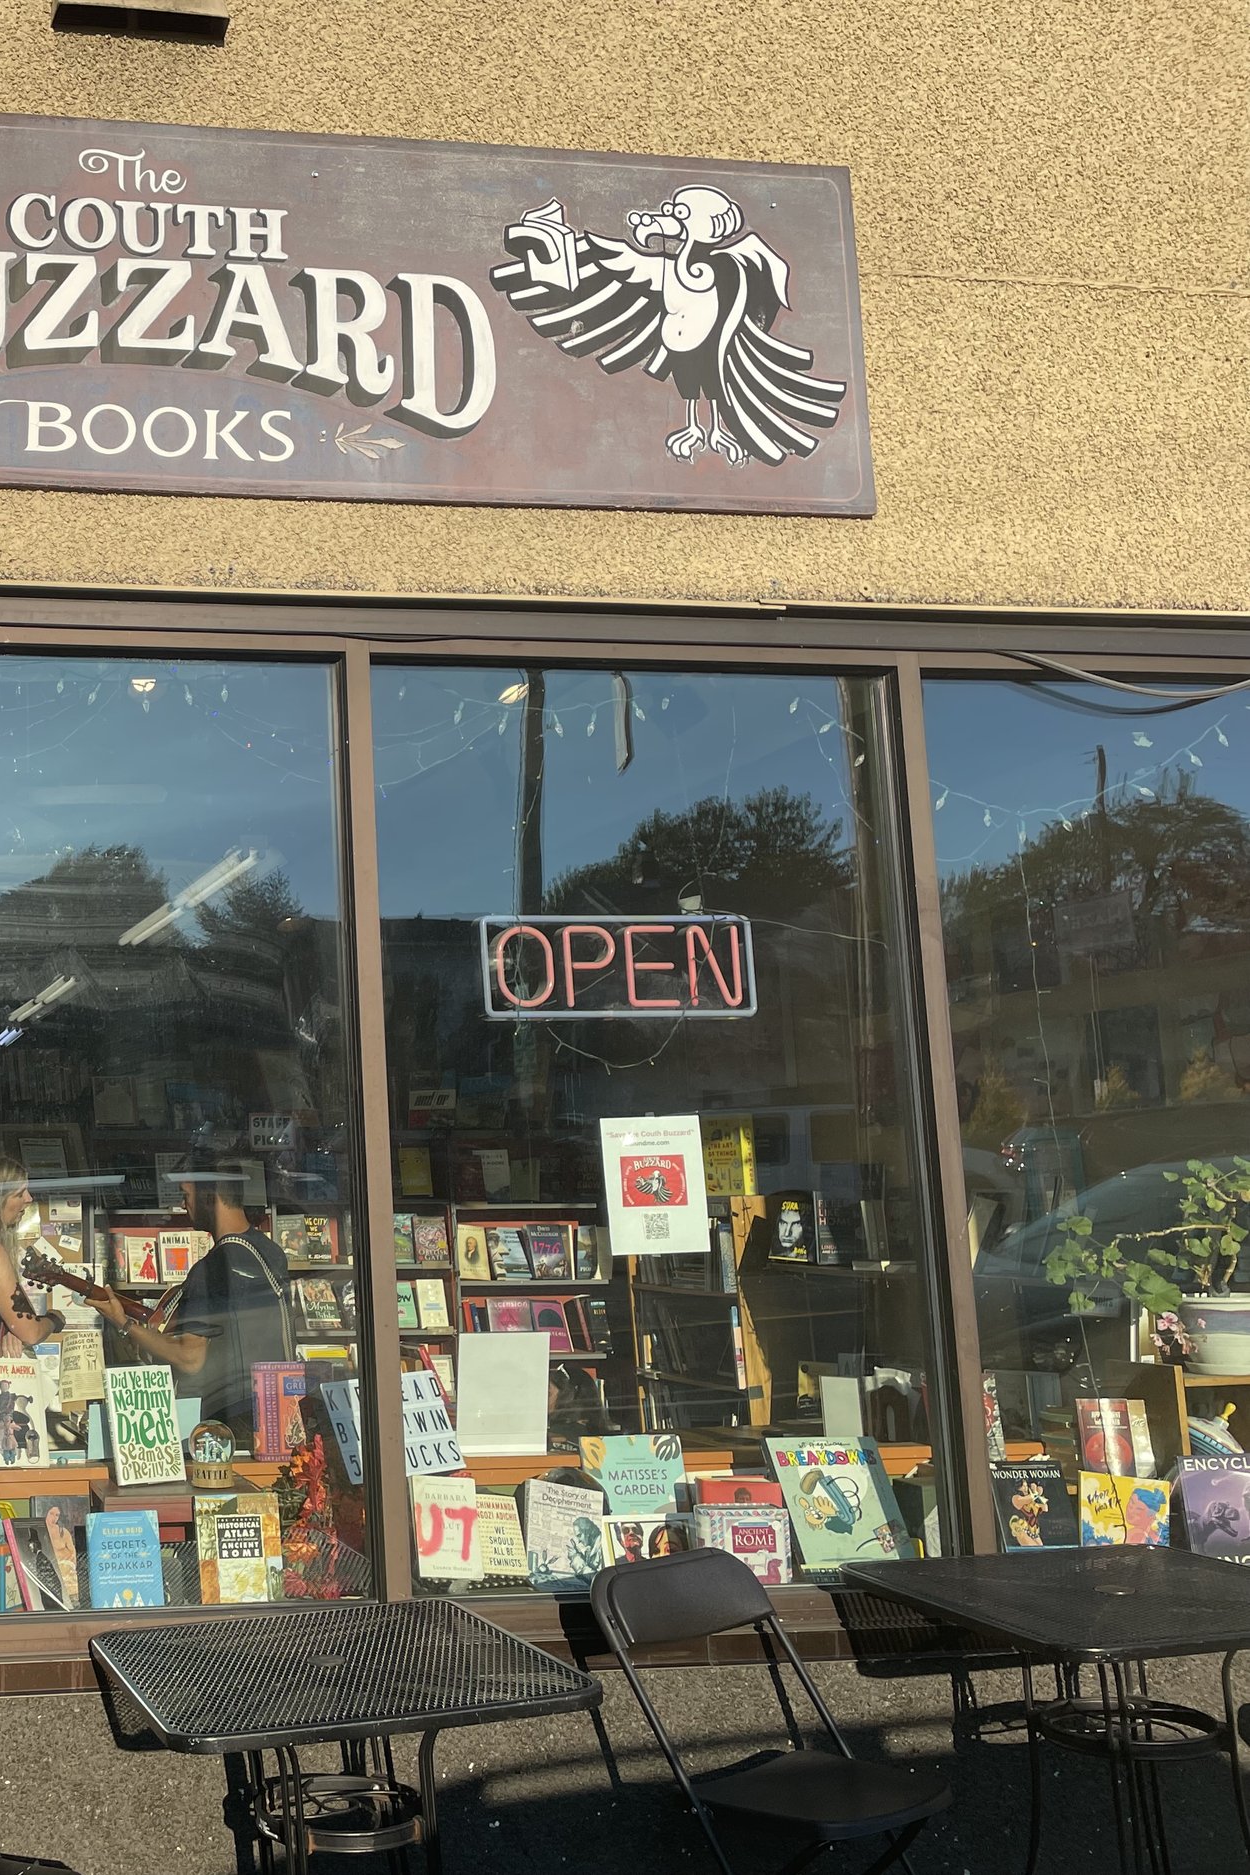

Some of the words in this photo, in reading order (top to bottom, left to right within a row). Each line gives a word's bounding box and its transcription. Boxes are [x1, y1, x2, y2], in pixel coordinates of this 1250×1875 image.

[78, 148, 186, 195] The
[6, 193, 289, 262] COUTH
[496, 925, 743, 1008] OPEN
[633, 1160, 671, 1171] BUZZARD
[313, 1218, 327, 1226] CITY
[161, 1236, 190, 1244] ANIMAL
[307, 1303, 335, 1311] Myths
[11, 1364, 36, 1376] AMERICA
[111, 1371, 128, 1389] Did
[128, 1371, 141, 1390] Ye
[142, 1370, 170, 1389] Hear
[112, 1388, 172, 1418] Mammy
[116, 1408, 178, 1449] Died?
[170, 1440, 181, 1476] memoir
[775, 1449, 878, 1467] BREAKDOWNS
[122, 1461, 164, 1481] O'Reilly
[608, 1468, 668, 1482] MATISSE'S
[992, 1470, 1029, 1479] WONDER
[1029, 1469, 1061, 1479] WOMAN
[547, 1486, 559, 1495] The
[561, 1489, 579, 1501] Story
[579, 1492, 588, 1500] of
[614, 1484, 666, 1496] GARDEN
[424, 1493, 468, 1502] BARBARA
[542, 1493, 592, 1510] Decipherment
[475, 1501, 515, 1511] CHIMAMANDA
[217, 1521, 260, 1529] HISTORICAL
[223, 1529, 256, 1538] ATLAS
[494, 1526, 506, 1536] WE
[738, 1527, 770, 1535] ANCIENT
[101, 1540, 147, 1550] SECRETS
[221, 1541, 259, 1549] ANCIENT
[489, 1536, 515, 1546] SHOULD
[735, 1534, 775, 1547] ROME
[111, 1552, 122, 1560] OF
[222, 1549, 260, 1558] ROME
[493, 1547, 506, 1556] ALL
[506, 1547, 514, 1556] BE
[98, 1560, 153, 1572] SPRAKKAR
[489, 1557, 522, 1568] FEMINISTS
